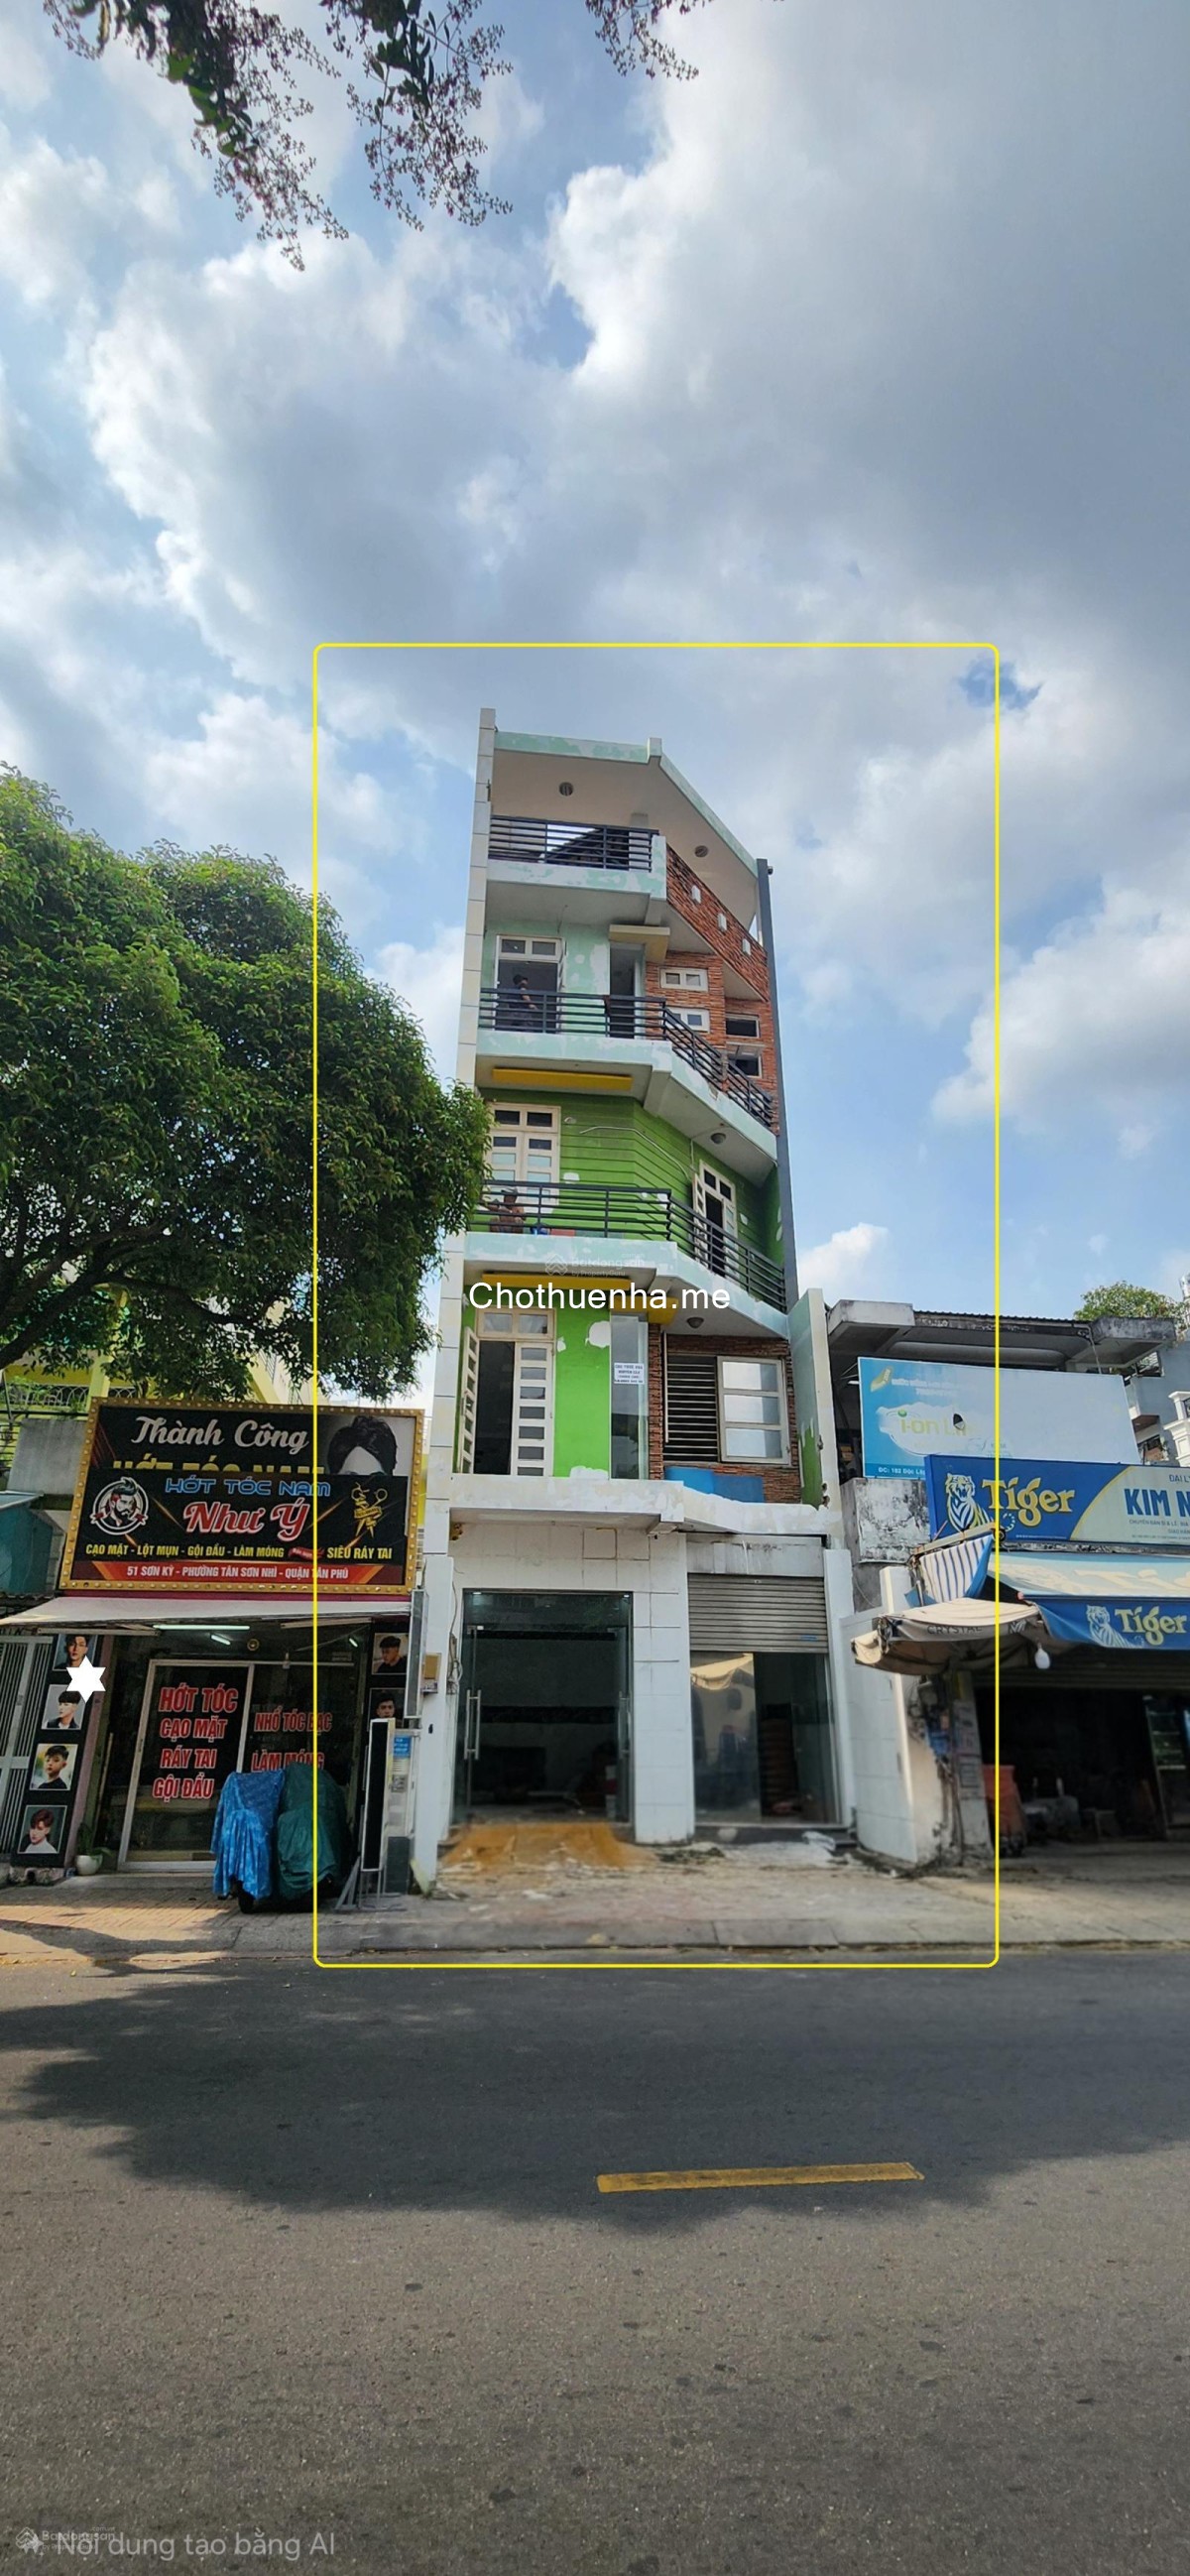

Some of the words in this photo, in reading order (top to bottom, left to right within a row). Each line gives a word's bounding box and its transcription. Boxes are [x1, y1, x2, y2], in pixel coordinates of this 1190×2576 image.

[131, 1415, 224, 1445] Thành
[234, 1419, 309, 1455] Công
[165, 1474, 216, 1494] HỚT
[224, 1476, 272, 1496] TÓC
[982, 1476, 1076, 1527] Tiger
[1124, 1488, 1171, 1517] KIM
[182, 1501, 266, 1534] Như
[270, 1497, 310, 1542] Ý
[85, 1543, 105, 1557] CẠO
[107, 1542, 129, 1558] MẶT
[156, 1545, 179, 1558] MỤN
[233, 1544, 254, 1557] LÀM
[326, 1543, 350, 1559] SIÊU
[353, 1545, 374, 1560] RÁY
[378, 1547, 393, 1560] TAI
[126, 1565, 138, 1576] 51
[141, 1565, 161, 1577] SƠN
[181, 1564, 219, 1577] PHƯỜNG
[240, 1566, 260, 1578] SƠN
[285, 1567, 309, 1580] QUẬN
[311, 1567, 329, 1579] ÂN
[1115, 1605, 1187, 1646] Tiger
[158, 1682, 198, 1713] HỚT
[201, 1682, 239, 1714] TÓC
[160, 1718, 191, 1742] CẠO
[193, 1715, 228, 1743] MẶT
[283, 1708, 306, 1733] TÓC
[160, 1745, 192, 1770] RÁY
[193, 1748, 218, 1770] TAI
[251, 1748, 283, 1774] LÀM
[153, 1774, 181, 1802] GỘI
[181, 1772, 215, 1799] ĐẦU
